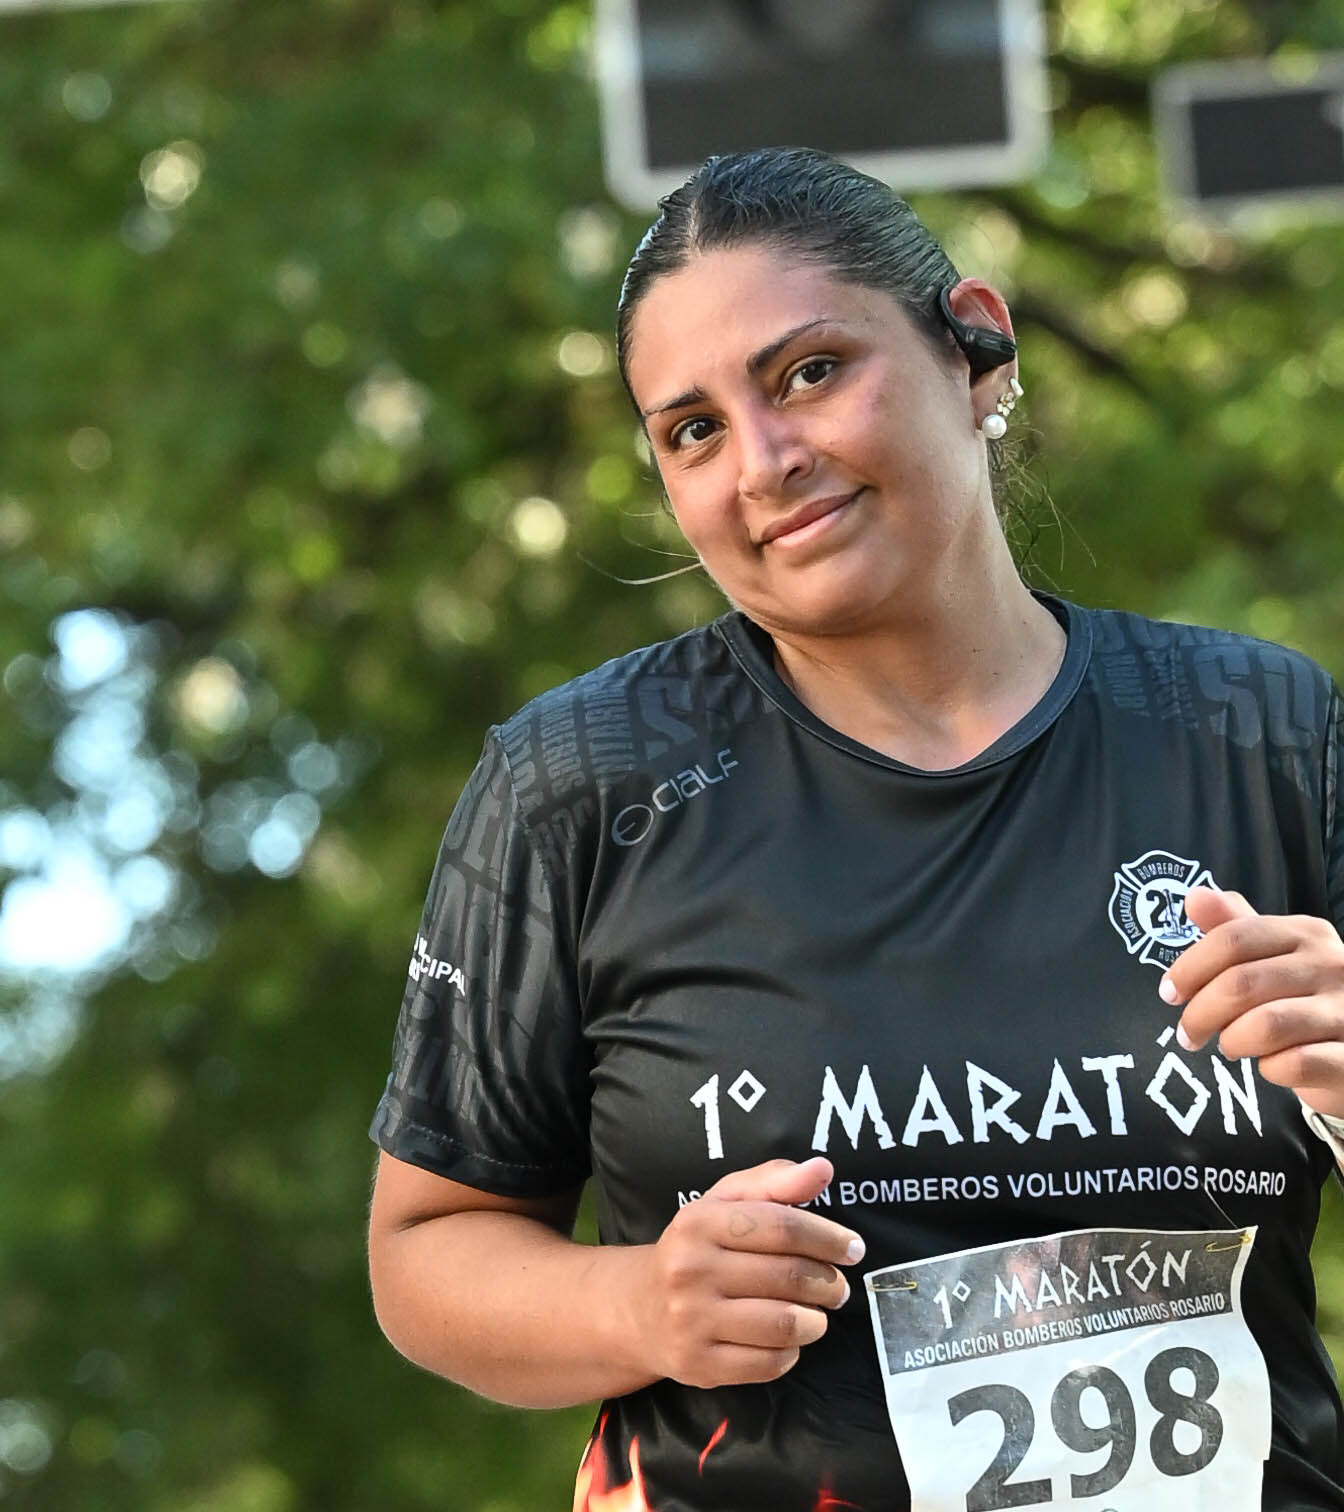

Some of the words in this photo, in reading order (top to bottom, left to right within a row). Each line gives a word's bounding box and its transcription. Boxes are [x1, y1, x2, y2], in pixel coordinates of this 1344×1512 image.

[1136, 862, 1186, 880] BOMBEROS
[811, 1026, 1263, 1153] MARATÓN
[839, 1175, 999, 1206] BOMBEROS
[1007, 1166, 1199, 1199] VOLUNTARIOS
[1203, 1168, 1287, 1197] ROSARIO
[993, 1240, 1192, 1319] MARATÓN
[903, 1333, 999, 1369] ASOCIACIÓN
[1005, 1316, 1083, 1349] BOMBEROS
[1086, 1302, 1169, 1334] VOLUNTARIOS
[1171, 1291, 1225, 1317] ROSARIO
